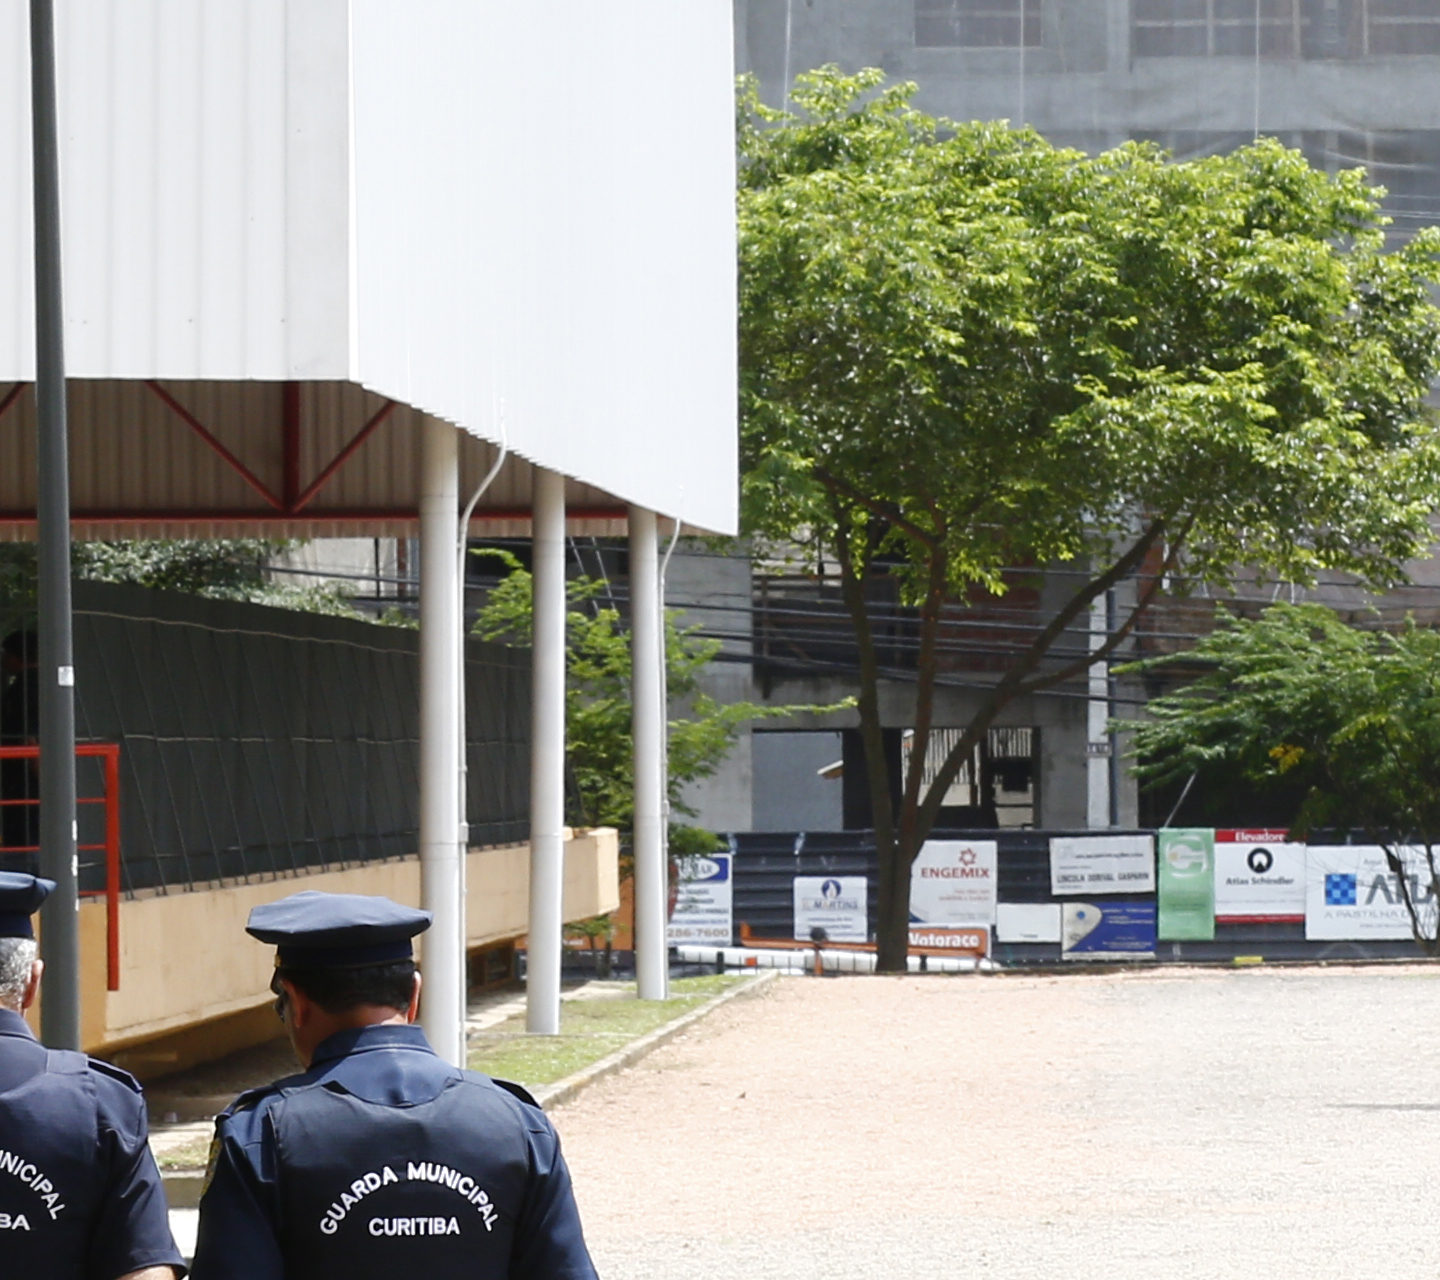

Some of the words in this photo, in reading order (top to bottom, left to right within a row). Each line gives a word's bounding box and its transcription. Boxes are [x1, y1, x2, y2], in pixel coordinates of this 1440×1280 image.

[1235, 831, 1289, 841] Elevadore
[921, 868, 990, 879] ENGEMIX
[1226, 877, 1249, 885] Atlas
[1251, 877, 1294, 885] Schindler
[319, 1166, 399, 1235] GUARDA
[407, 1162, 499, 1232] MUNICIPAL
[368, 1216, 461, 1236] CURITIBA
